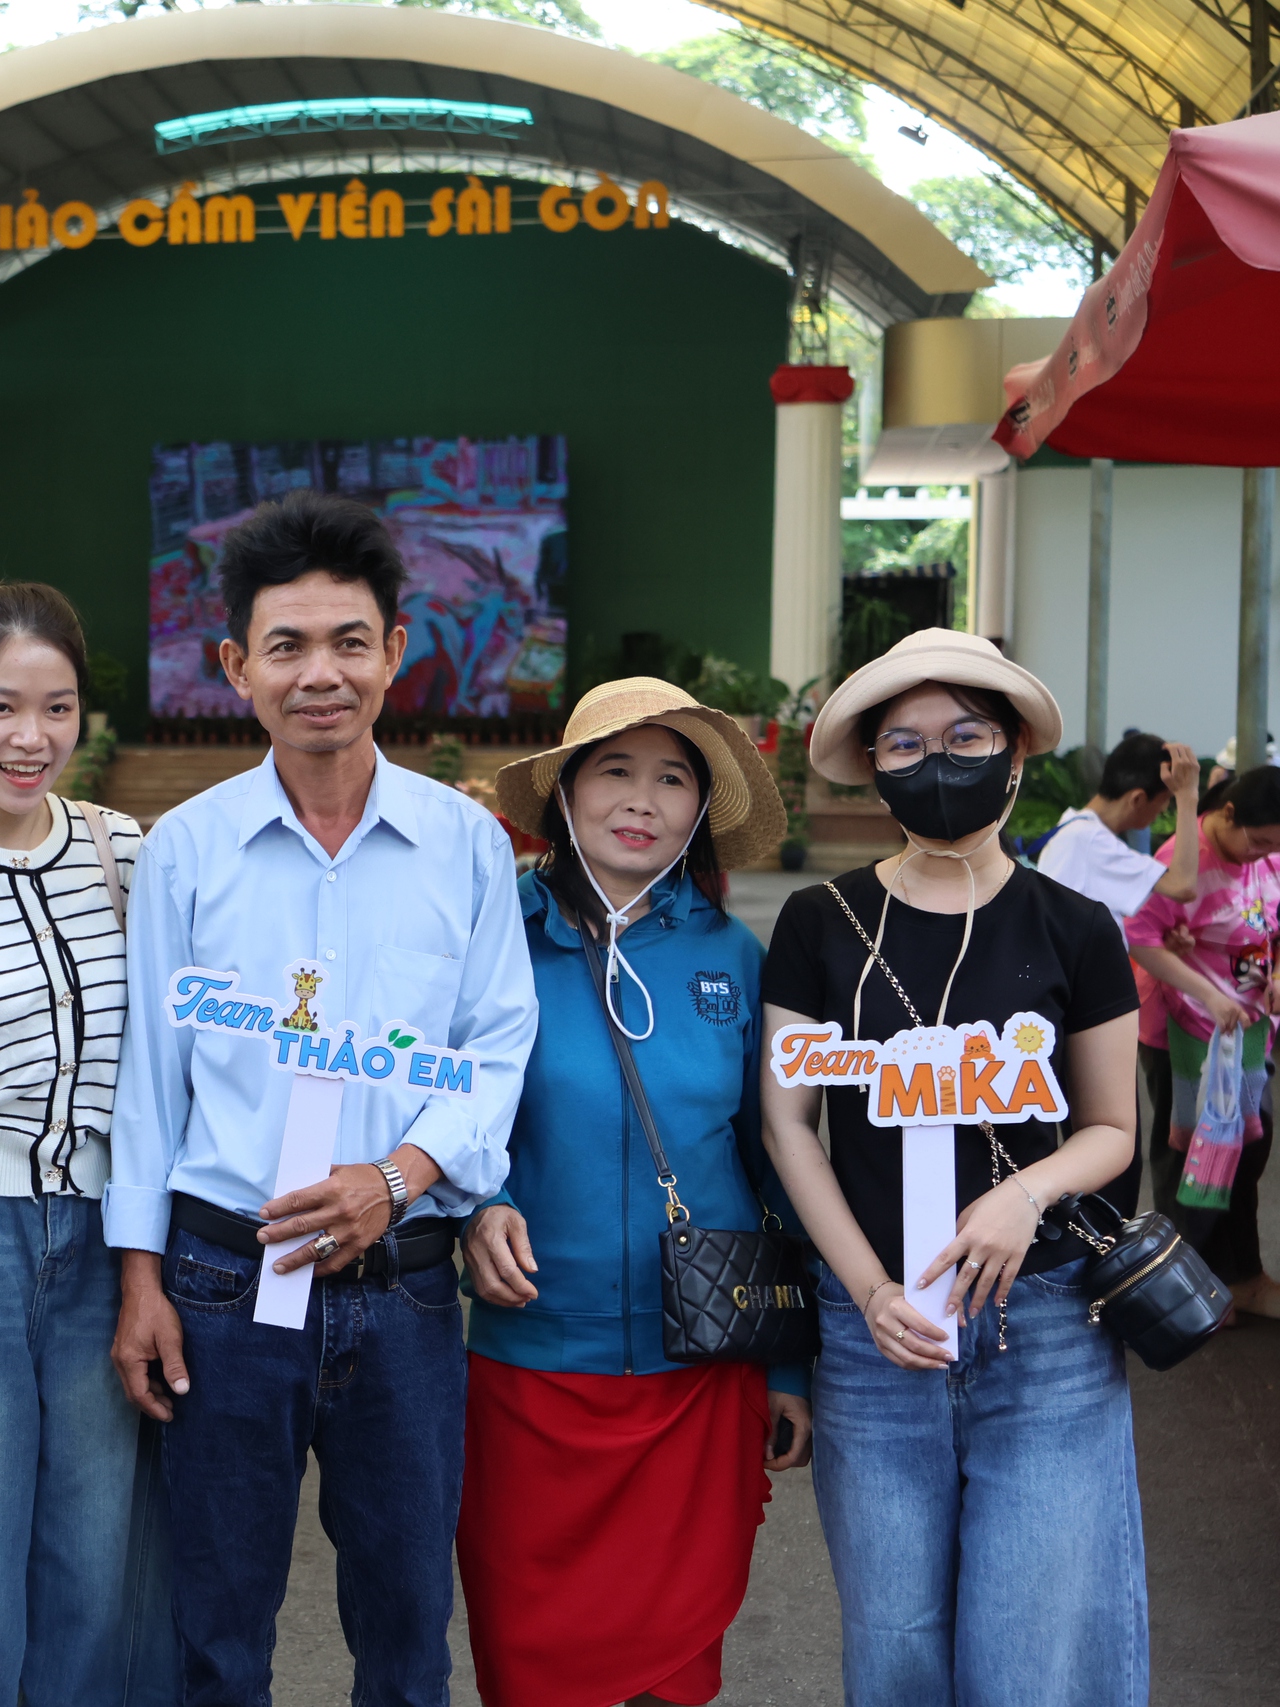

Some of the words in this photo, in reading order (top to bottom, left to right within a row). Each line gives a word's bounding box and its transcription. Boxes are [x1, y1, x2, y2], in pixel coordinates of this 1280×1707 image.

[276, 177, 405, 242] VIÊN
[427, 174, 513, 238] SÀI
[538, 170, 670, 233] GÒN
[172, 975, 275, 1033] Team
[700, 981, 730, 994] BTS
[273, 1029, 395, 1080] THẢO
[407, 1052, 473, 1094] EM
[780, 1031, 878, 1079] Team
[877, 1059, 1059, 1118] MIKA
